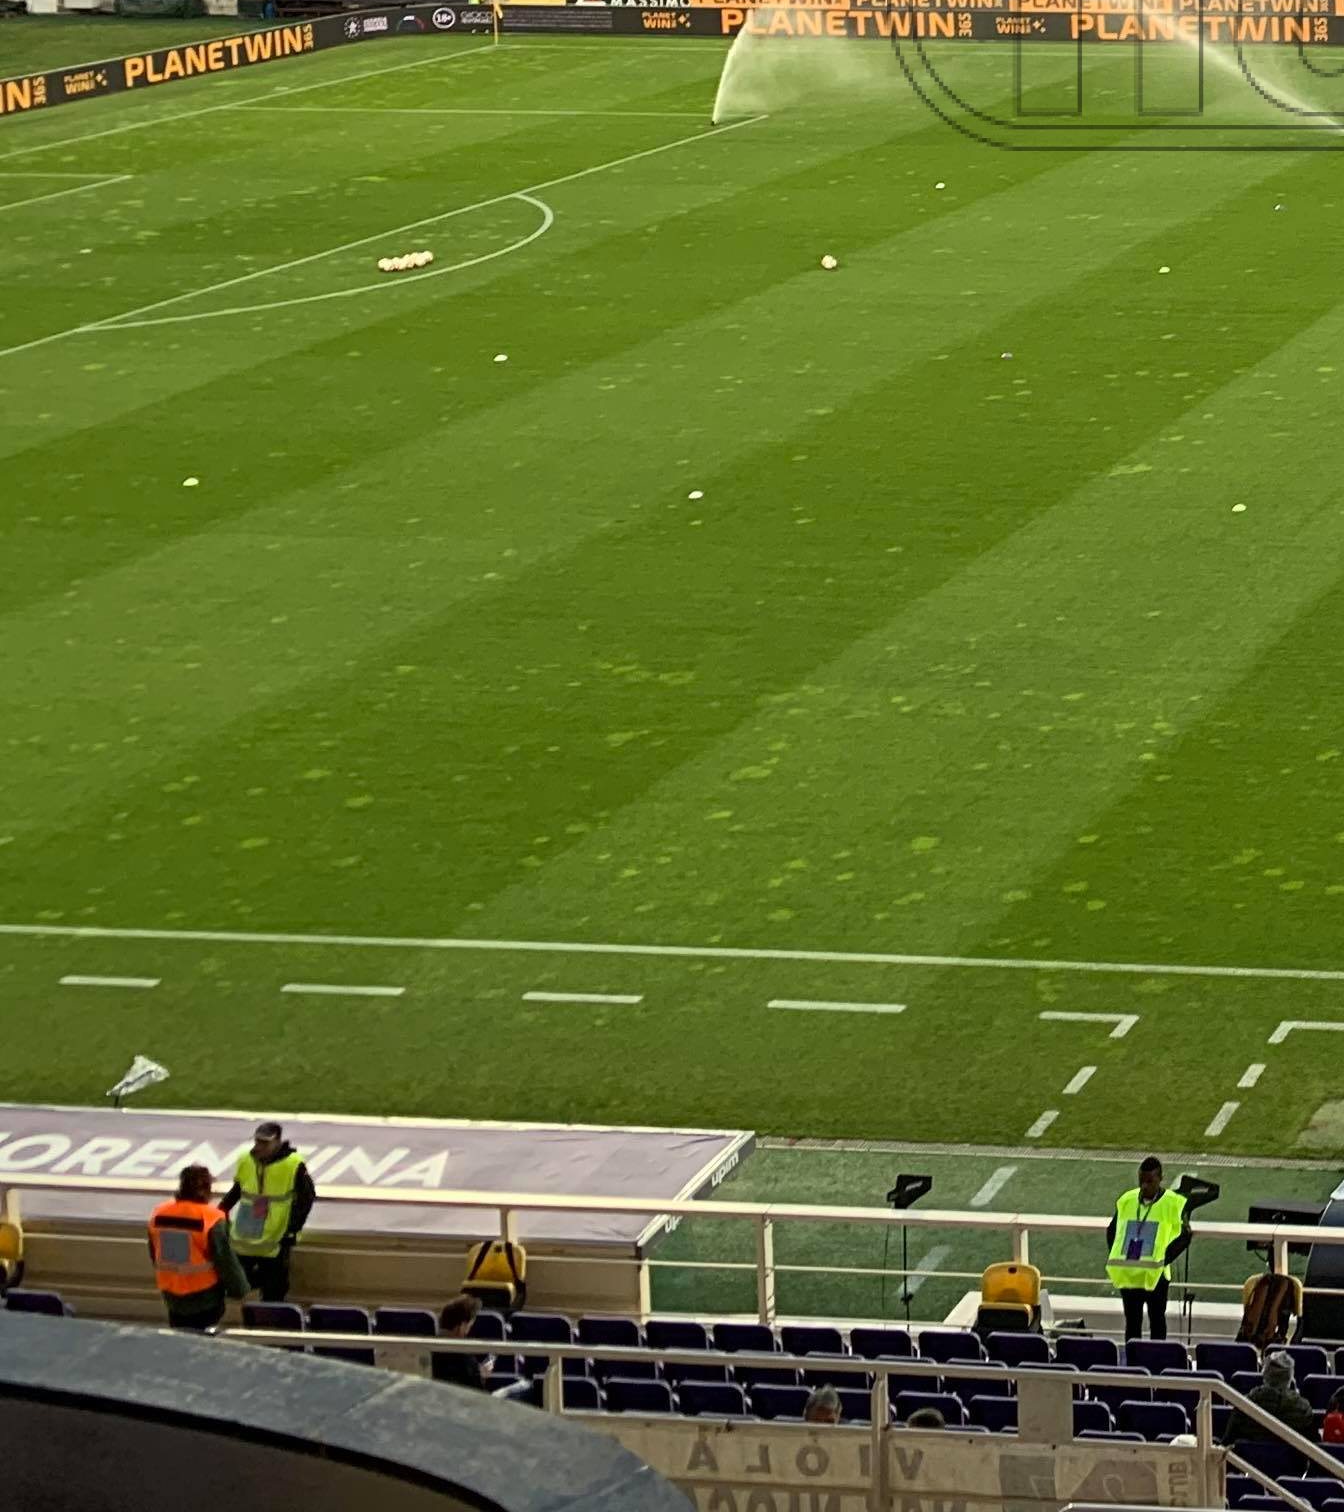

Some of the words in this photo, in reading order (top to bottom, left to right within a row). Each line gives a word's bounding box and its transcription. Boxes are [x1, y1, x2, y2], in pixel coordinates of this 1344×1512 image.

[721, 8, 954, 37] PLANETWIN
[1071, 15, 1310, 42] PLANETWIN
[124, 25, 301, 88] PLANETWIN
[0, 1131, 450, 1190] ORENINA
[711, 1150, 740, 1188] upim
